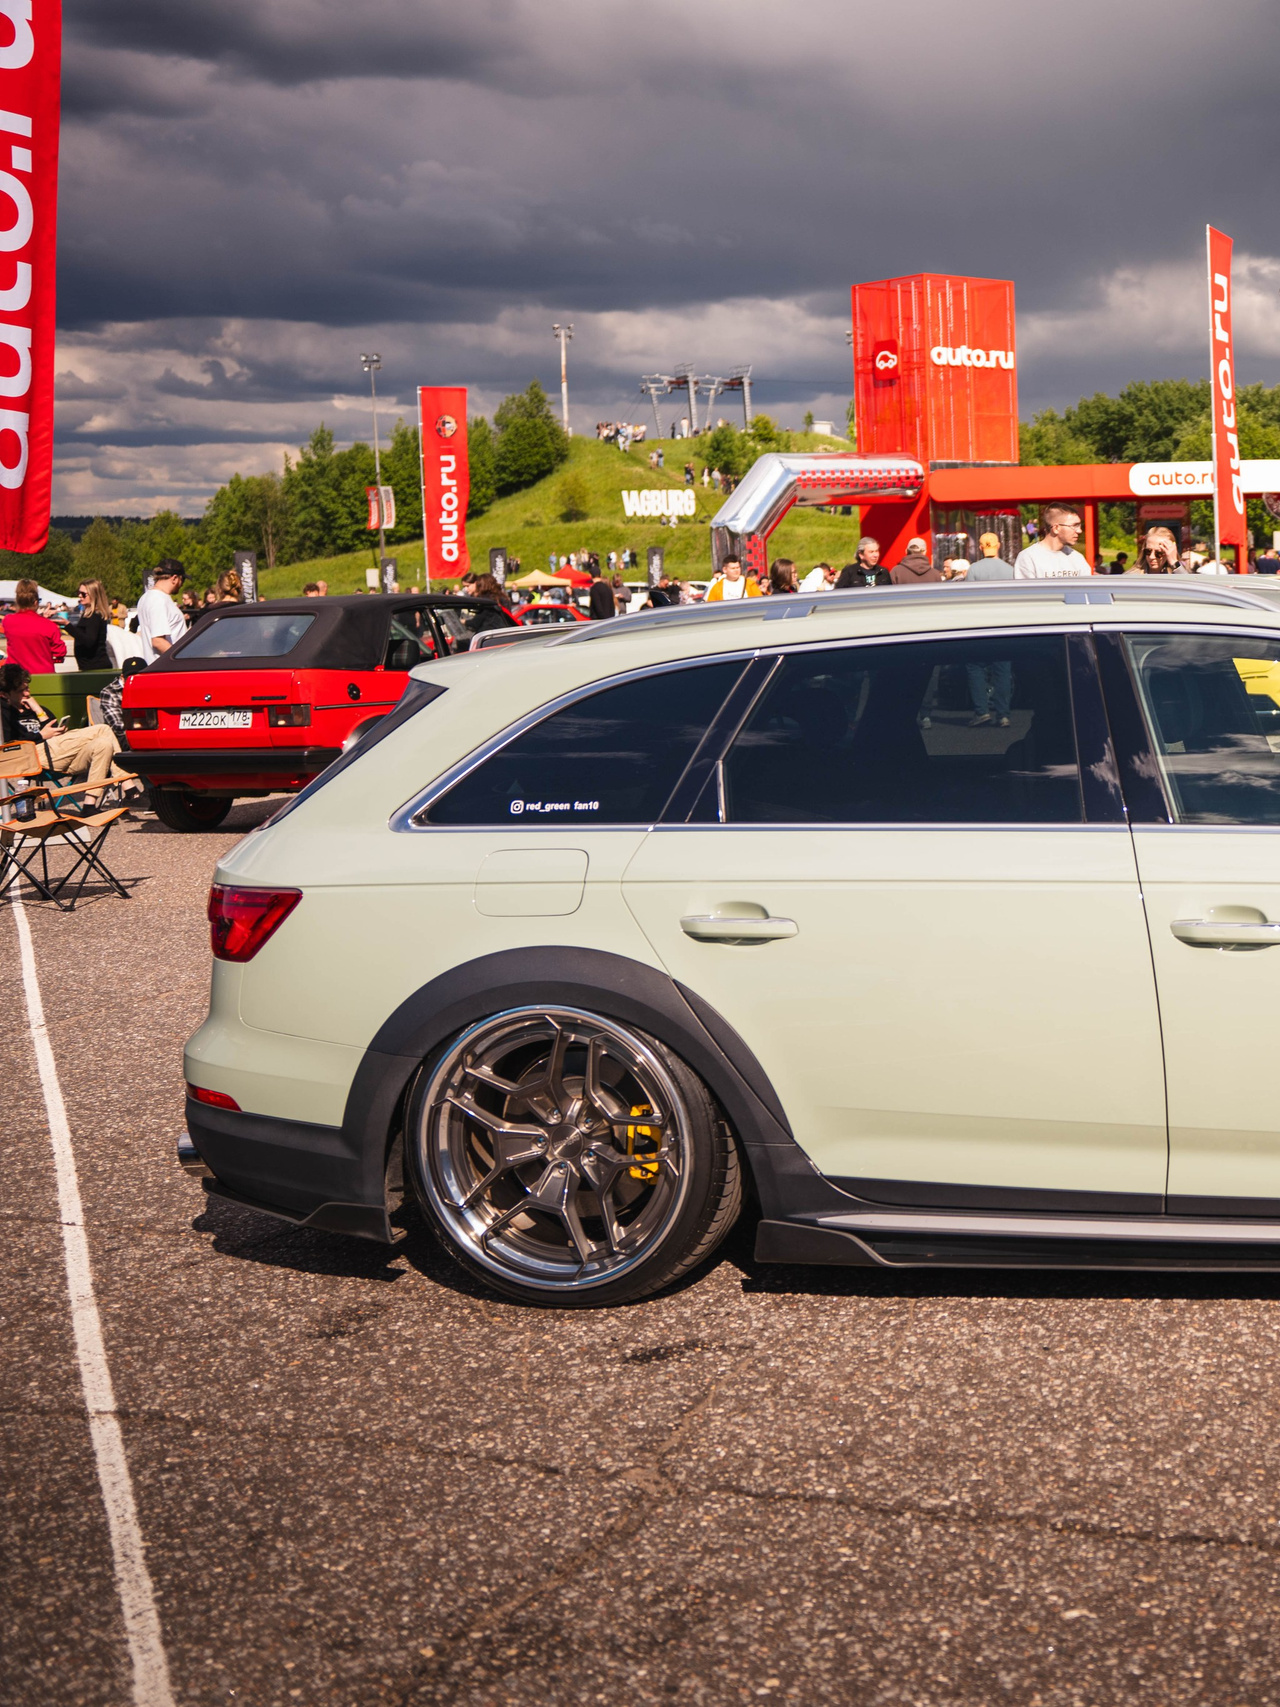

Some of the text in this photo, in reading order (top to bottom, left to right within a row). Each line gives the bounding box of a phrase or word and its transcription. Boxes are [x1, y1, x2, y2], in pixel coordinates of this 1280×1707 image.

[930, 345, 1014, 369] auto.ru
[1148, 472, 1216, 486] auto.r
[439, 455, 459, 562] auto.ru
[621, 488, 696, 516] VAGBURG
[231, 711, 248, 722] 178
[525, 801, 600, 813] red_green fan10
